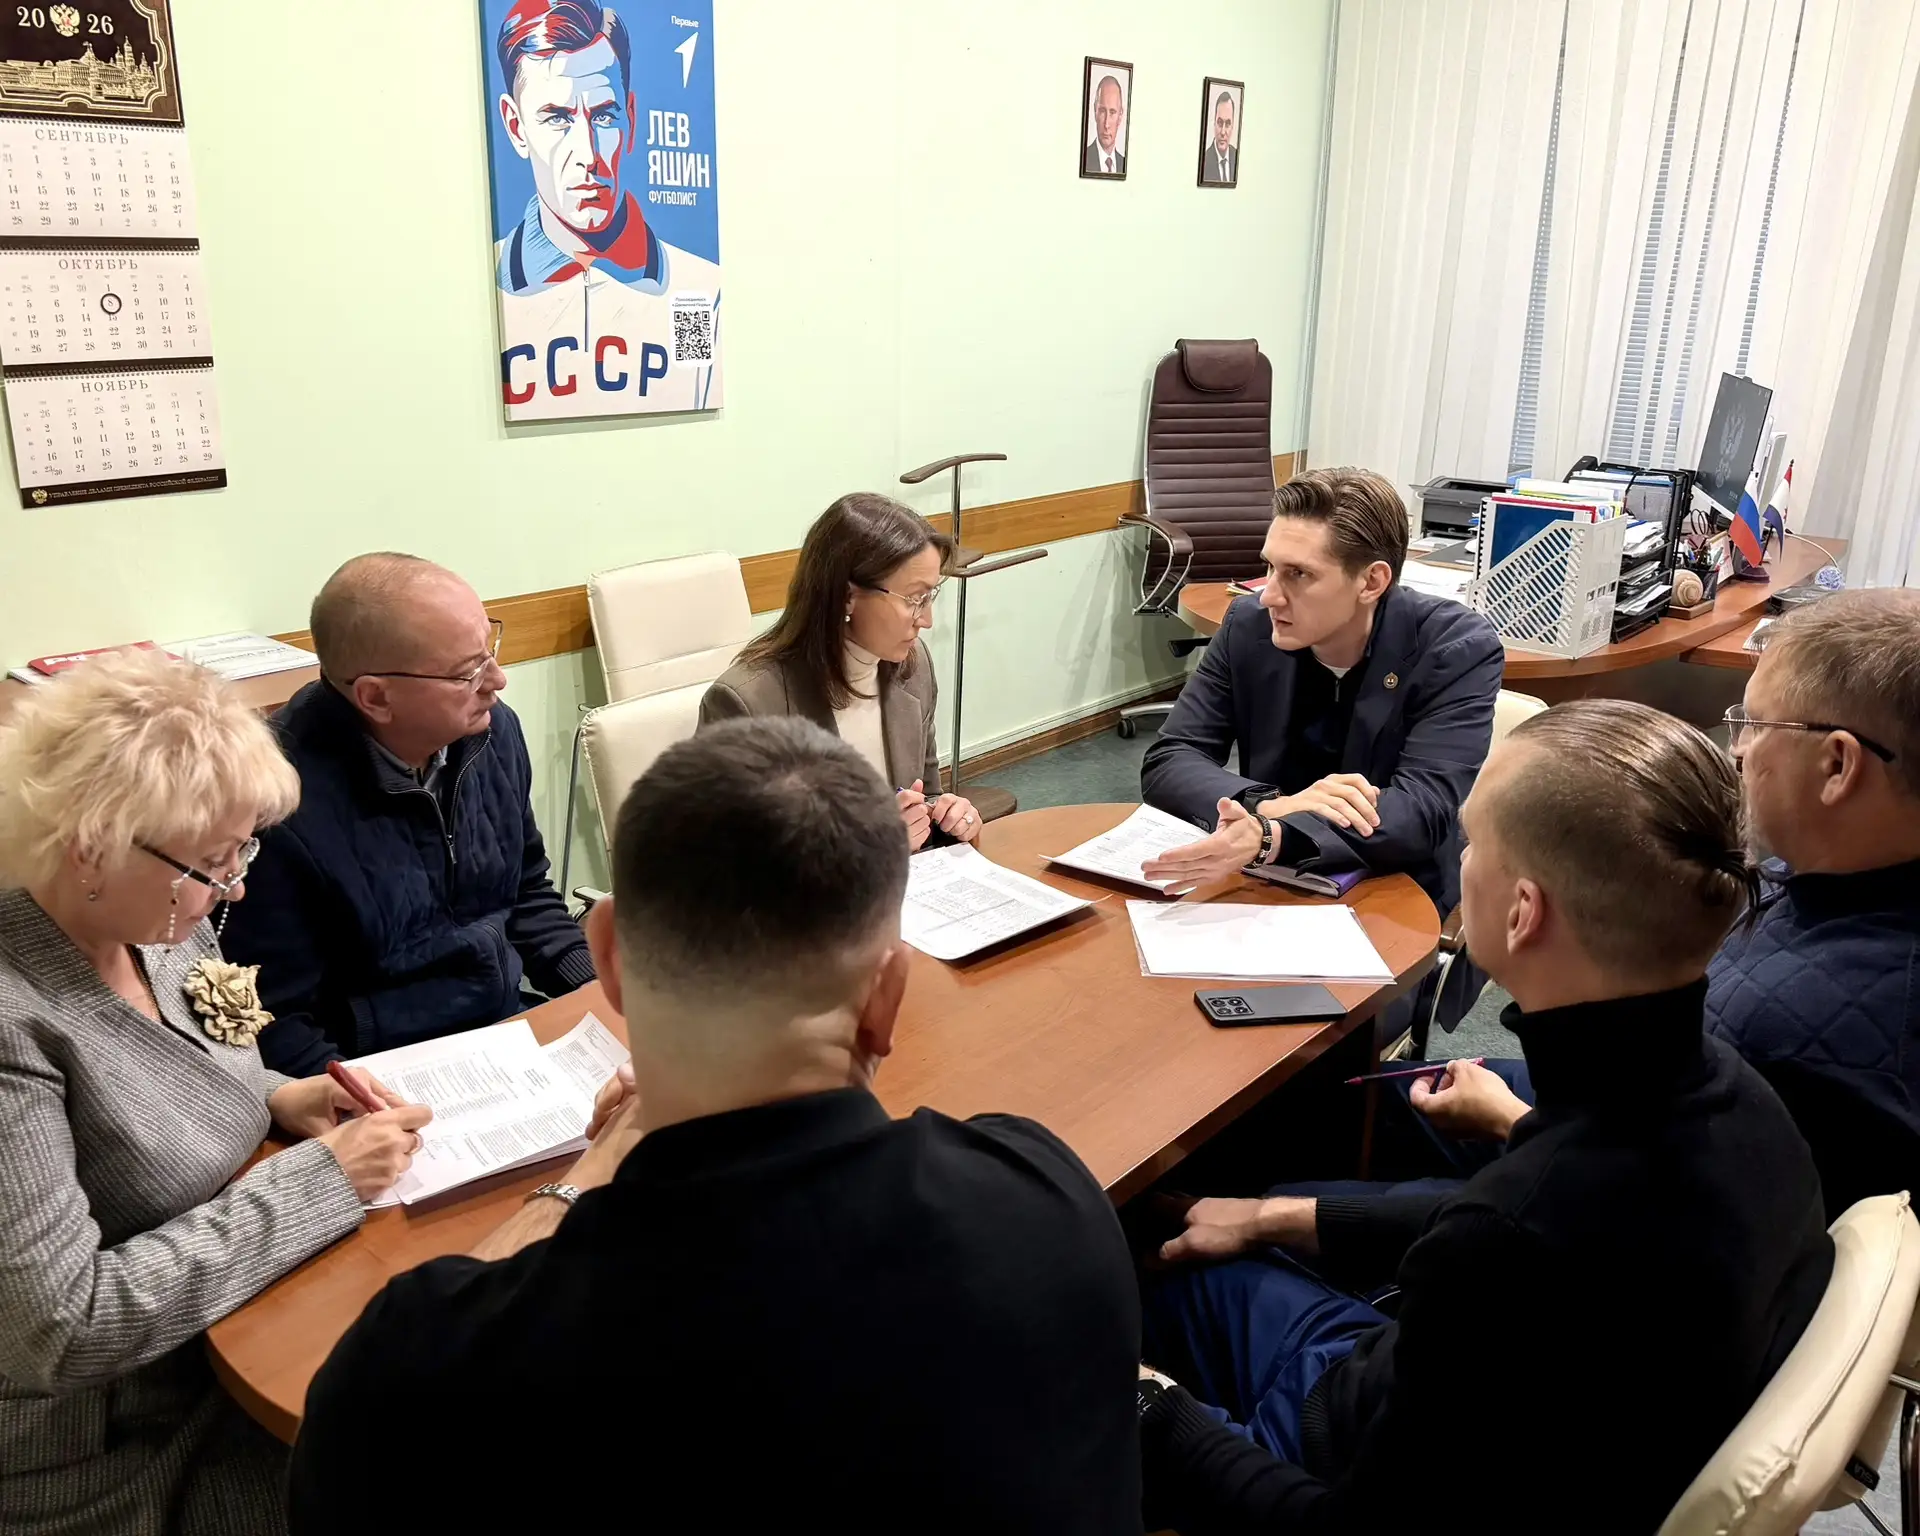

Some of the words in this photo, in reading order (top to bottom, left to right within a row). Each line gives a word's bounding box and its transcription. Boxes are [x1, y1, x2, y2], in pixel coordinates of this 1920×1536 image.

[17, 6, 45, 28] 20
[87, 14, 114, 35] 26
[671, 15, 699, 28] Первые
[647, 109, 691, 148] ЛЕВ
[35, 129, 129, 145] СЕНТЯБРЬ
[34, 155, 40, 164] 1
[62, 156, 68, 165] 2
[90, 157, 96, 166] 3
[117, 159, 123, 167] 4
[144, 160, 150, 168] 5
[170, 161, 175, 169] 6
[648, 150, 711, 188] ЯШИН
[7, 169, 13, 178] 7
[37, 171, 42, 179] 8
[65, 172, 70, 180] 9
[92, 173, 100, 181] 10
[119, 174, 126, 182] 11
[145, 175, 154, 183] 12
[171, 176, 179, 184] 13
[9, 185, 18, 194] 14
[38, 186, 47, 195] 15
[66, 187, 75, 195] 16
[94, 187, 101, 196] 17
[121, 189, 129, 197] 18
[147, 190, 155, 198] 19
[172, 190, 181, 199] 20
[648, 190, 697, 206] ФУТБОЛИСТ
[10, 200, 20, 209] 21
[39, 201, 49, 210] 22
[67, 202, 77, 211] 23
[95, 203, 104, 211] 24
[121, 204, 131, 212] 25
[148, 204, 157, 212] 26
[173, 205, 181, 213] 27
[12, 216, 23, 225] 28
[41, 217, 51, 225] 29
[69, 217, 79, 225] 30
[58, 259, 138, 270] ОКТЯБРЬ
[106, 284, 111, 292] 1
[132, 283, 137, 292] 2
[159, 283, 164, 291] 3
[27, 300, 32, 308] 5
[80, 298, 86, 307] 7
[107, 299, 114, 307] 8
[134, 298, 139, 306] 9
[159, 298, 168, 306] 10
[185, 297, 192, 305] 11
[28, 315, 36, 323] 12
[55, 314, 64, 322] 13
[82, 314, 90, 322] 14
[135, 312, 143, 320] 16
[161, 312, 168, 320] 17
[187, 311, 195, 319] 18
[30, 330, 39, 338] 19
[56, 329, 66, 337] 20
[83, 328, 92, 336] 21
[109, 327, 119, 335] 22
[136, 326, 145, 334] 23
[162, 326, 171, 334] 24
[188, 325, 197, 333] 25
[31, 345, 41, 353] 26
[58, 343, 67, 352] 27
[112, 342, 121, 350] 29
[164, 340, 172, 348] 31
[501, 335, 669, 405] СССР
[81, 379, 149, 393] НОЯБРЬ
[45, 424, 50, 432] 2
[72, 422, 77, 430] 3
[99, 420, 104, 428] 4
[125, 418, 130, 426] 5
[174, 414, 180, 422] 7
[100, 434, 107, 442] 11
[126, 432, 134, 440] 12
[152, 430, 160, 438] 13
[176, 428, 184, 436] 14
[201, 426, 209, 434] 15
[48, 452, 57, 461] 16
[75, 450, 83, 458] 17
[102, 448, 111, 456] 18
[128, 446, 136, 454] 19
[153, 444, 161, 452] 20
[177, 442, 186, 450] 21
[102, 462, 112, 470] 25
[154, 457, 162, 465] 27
[179, 455, 188, 463] 28
[203, 453, 212, 461] 29
